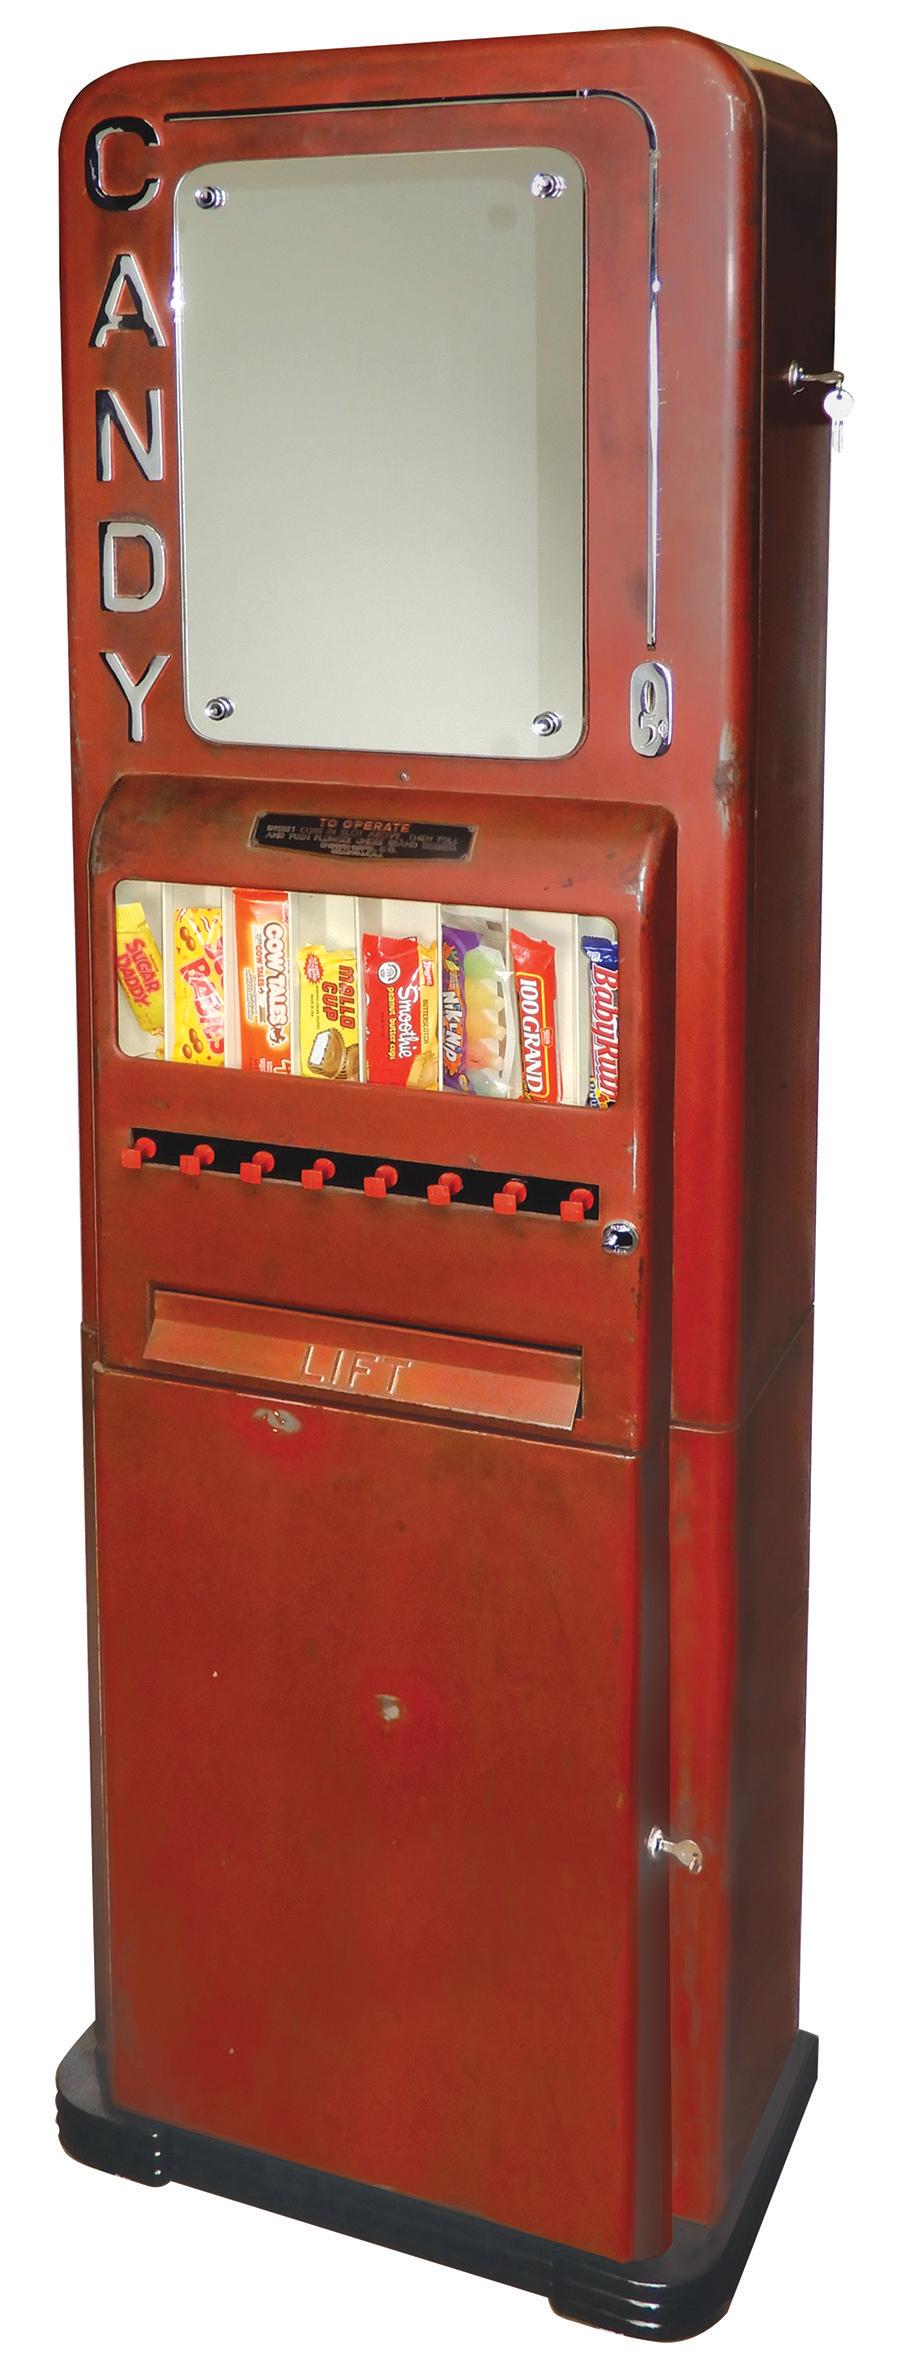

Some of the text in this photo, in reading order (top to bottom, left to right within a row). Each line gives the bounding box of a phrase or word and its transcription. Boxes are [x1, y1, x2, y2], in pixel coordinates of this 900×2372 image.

[85, 115, 171, 743] CANDY
[319, 817, 411, 833] TO OPERATE
[117, 953, 149, 1006] DADDY
[125, 937, 160, 993] SUGAR
[256, 945, 264, 964] COW
[264, 923, 288, 1025] COW TALES
[322, 981, 338, 1021] CUP
[339, 965, 355, 1029] MALLO
[387, 987, 395, 1016] peanut
[398, 986, 420, 1059] Smoothie
[388, 1043, 396, 1060] cups
[520, 979, 542, 1092] 100 GRAND
[300, 1343, 412, 1395] LIFT
